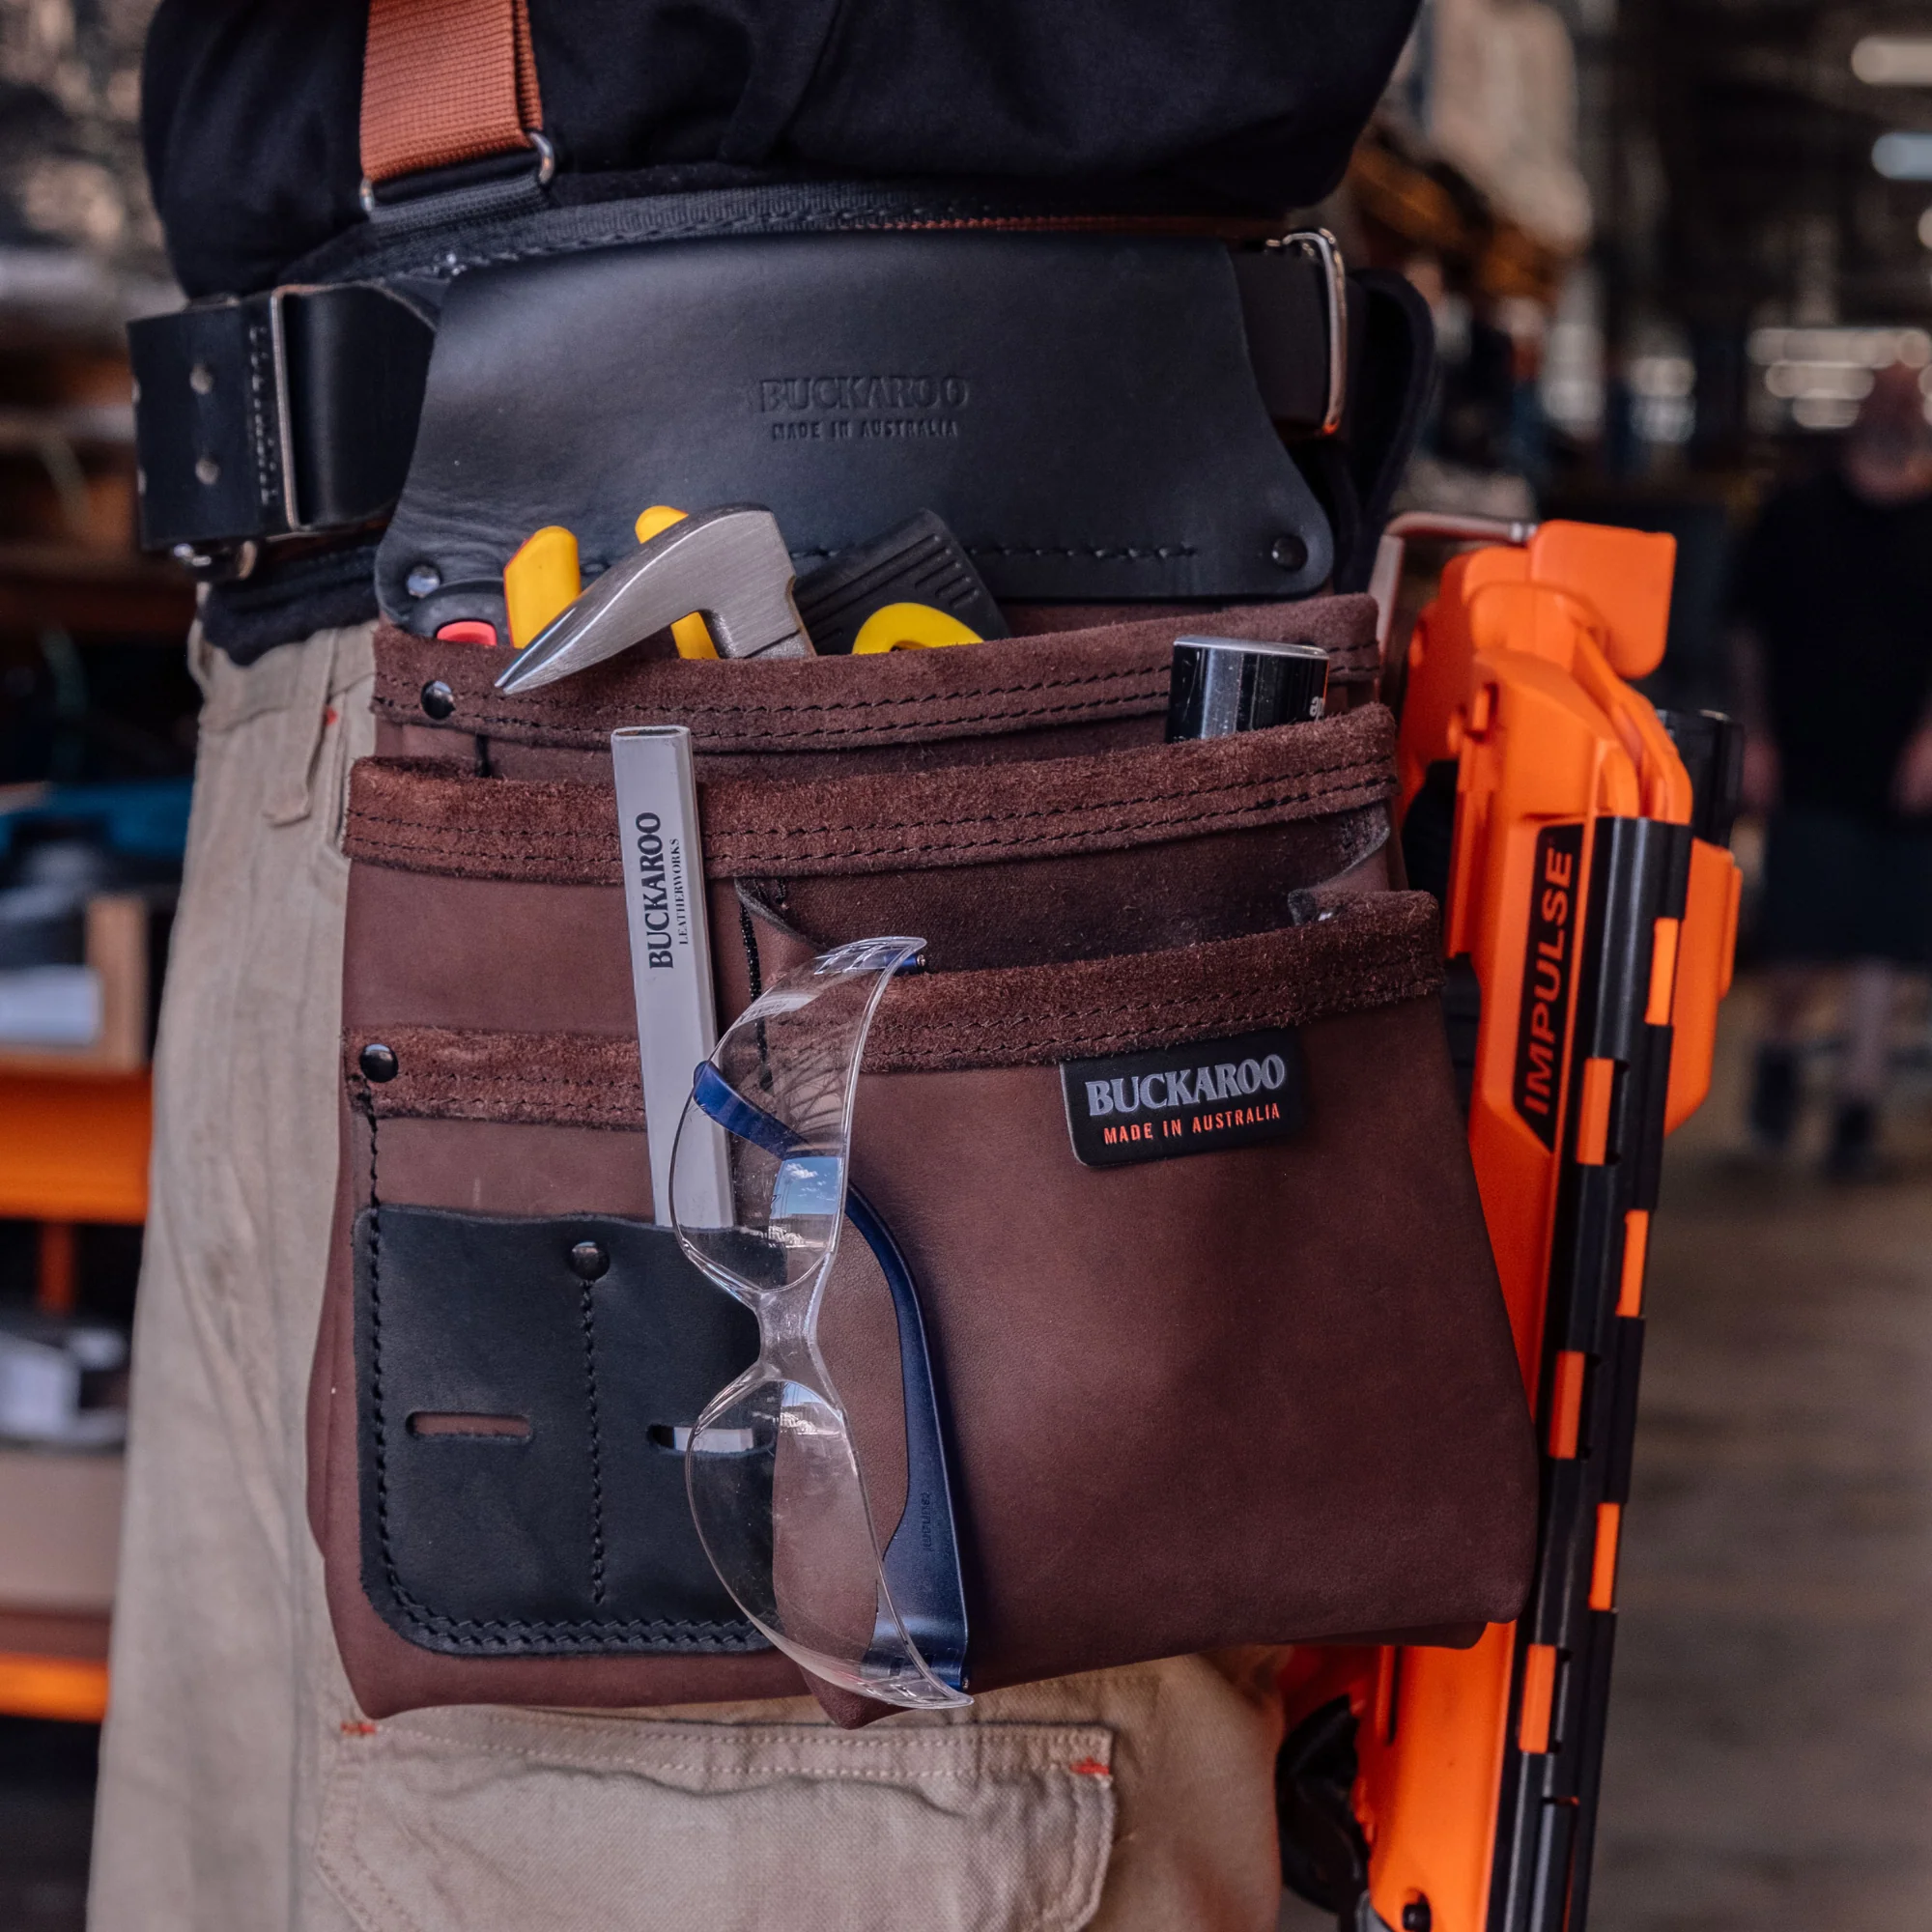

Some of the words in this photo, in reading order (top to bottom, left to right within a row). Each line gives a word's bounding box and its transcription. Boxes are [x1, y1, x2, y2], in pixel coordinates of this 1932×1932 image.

[760, 375, 969, 412] BUCKAROO
[772, 422, 821, 440] MADE
[832, 420, 854, 438] IN
[862, 419, 960, 438] AUSTRALIA
[635, 811, 674, 970] BUCKAROO
[668, 838, 690, 946] LEATHERWORKS
[1523, 846, 1574, 1115] IMPULSE
[1084, 1053, 1286, 1117] BUCKAROO
[1103, 1121, 1153, 1146] MADE
[1162, 1118, 1182, 1138] IN
[1191, 1101, 1281, 1135] AUSTRALIA
